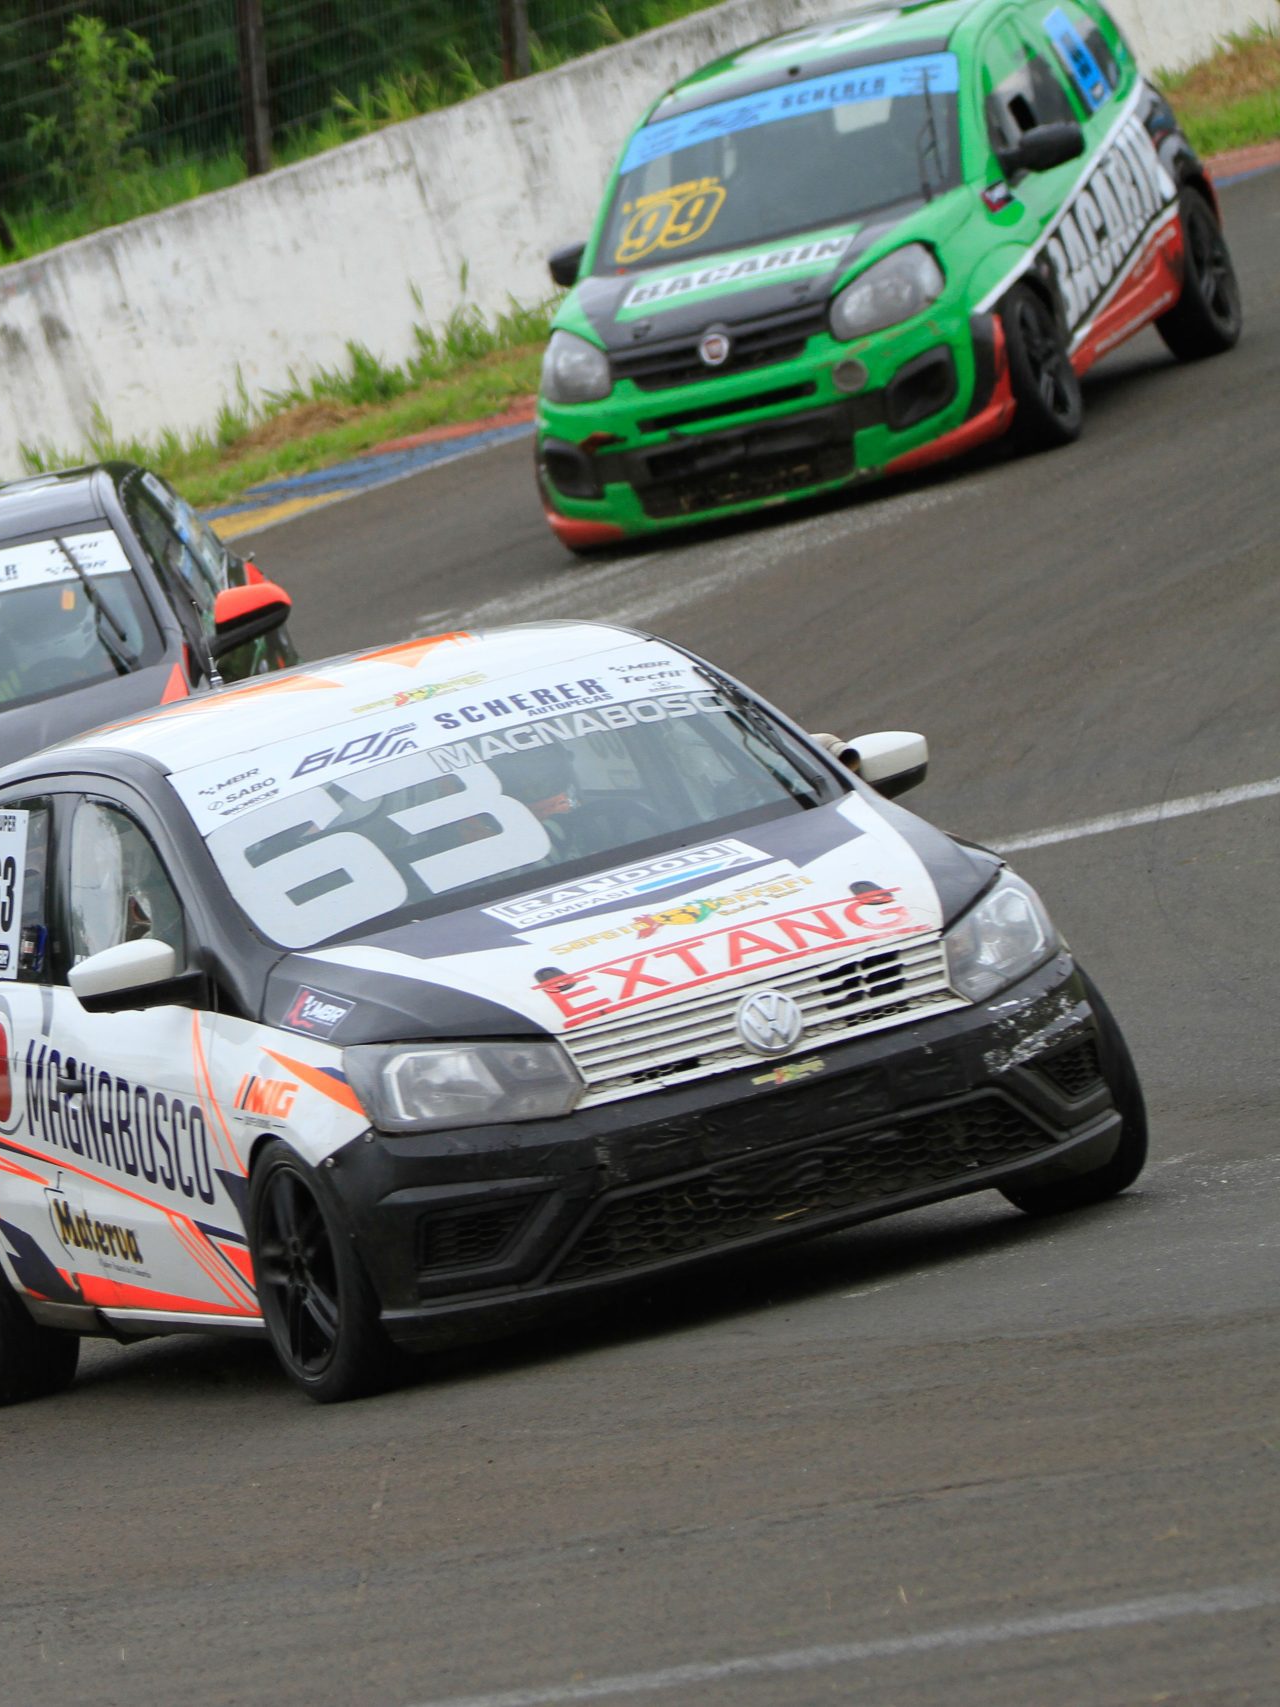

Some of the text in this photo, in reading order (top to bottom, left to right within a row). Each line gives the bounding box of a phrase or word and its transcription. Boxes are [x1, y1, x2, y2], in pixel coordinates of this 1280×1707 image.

[434, 678, 608, 730] SCHERER
[618, 670, 683, 684] Tecfil
[428, 690, 732, 773] MAGNABOSC
[206, 752, 551, 949] 63
[509, 845, 730, 914] RANDON
[543, 894, 913, 1018] EXTANG
[25, 1039, 215, 1205] MAGNABOSCO
